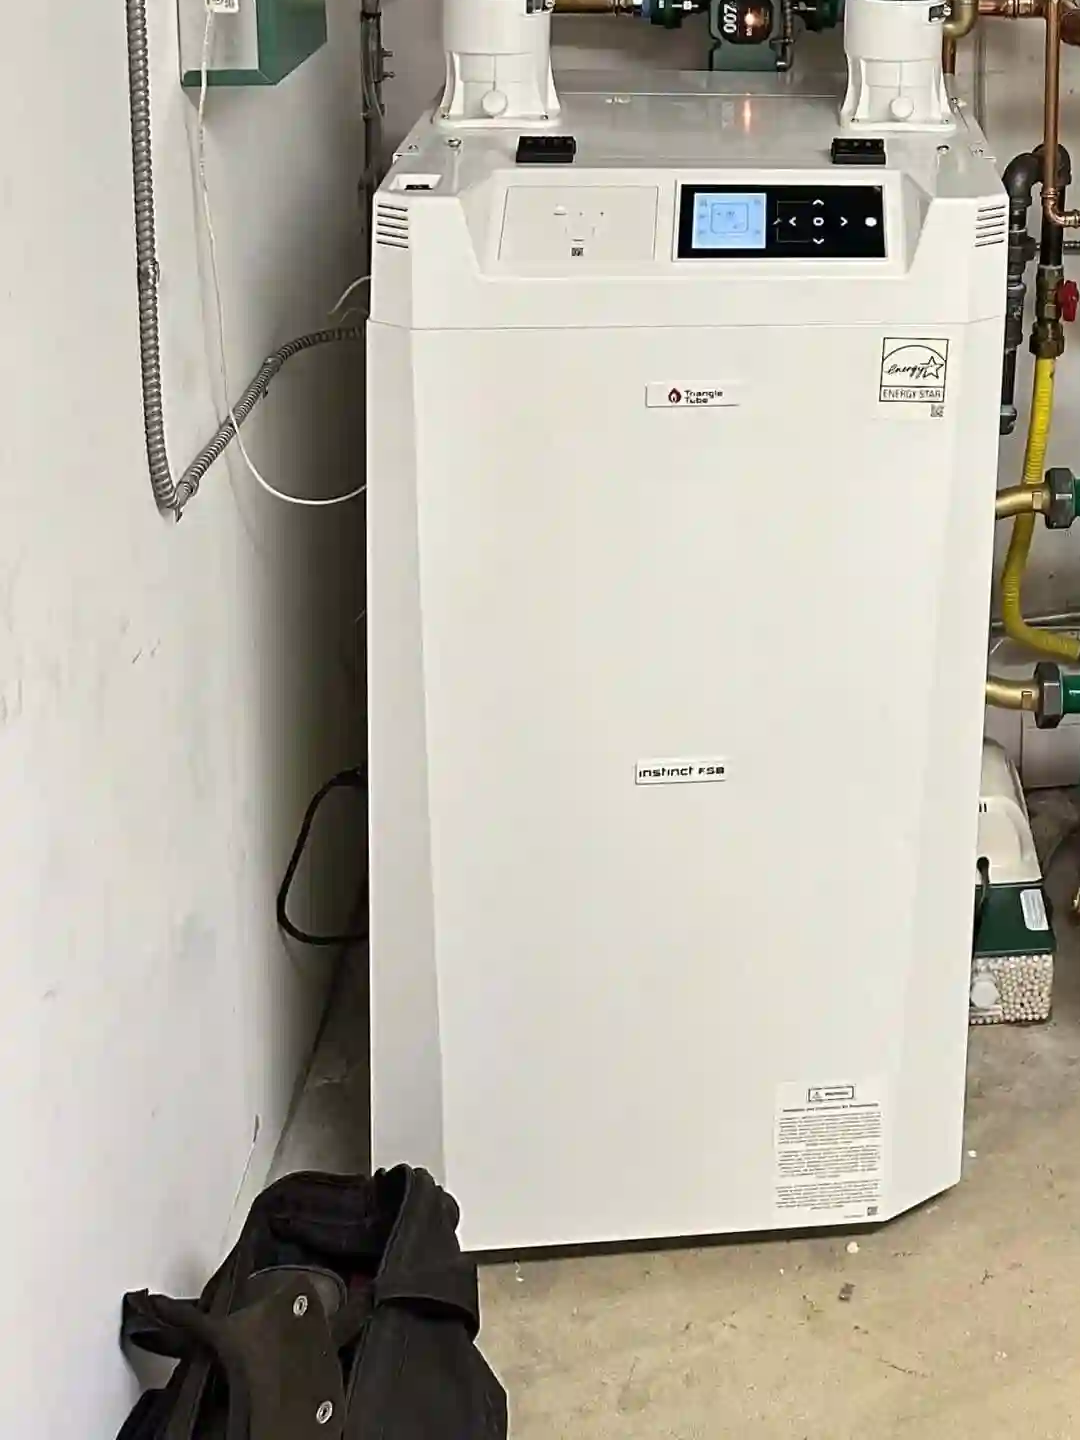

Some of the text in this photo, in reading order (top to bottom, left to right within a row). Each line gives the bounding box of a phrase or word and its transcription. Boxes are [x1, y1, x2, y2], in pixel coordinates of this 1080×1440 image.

[683, 389, 724, 400] Triangle
[883, 389, 941, 398] ENERGY STAR
[683, 396, 709, 405] Tube
